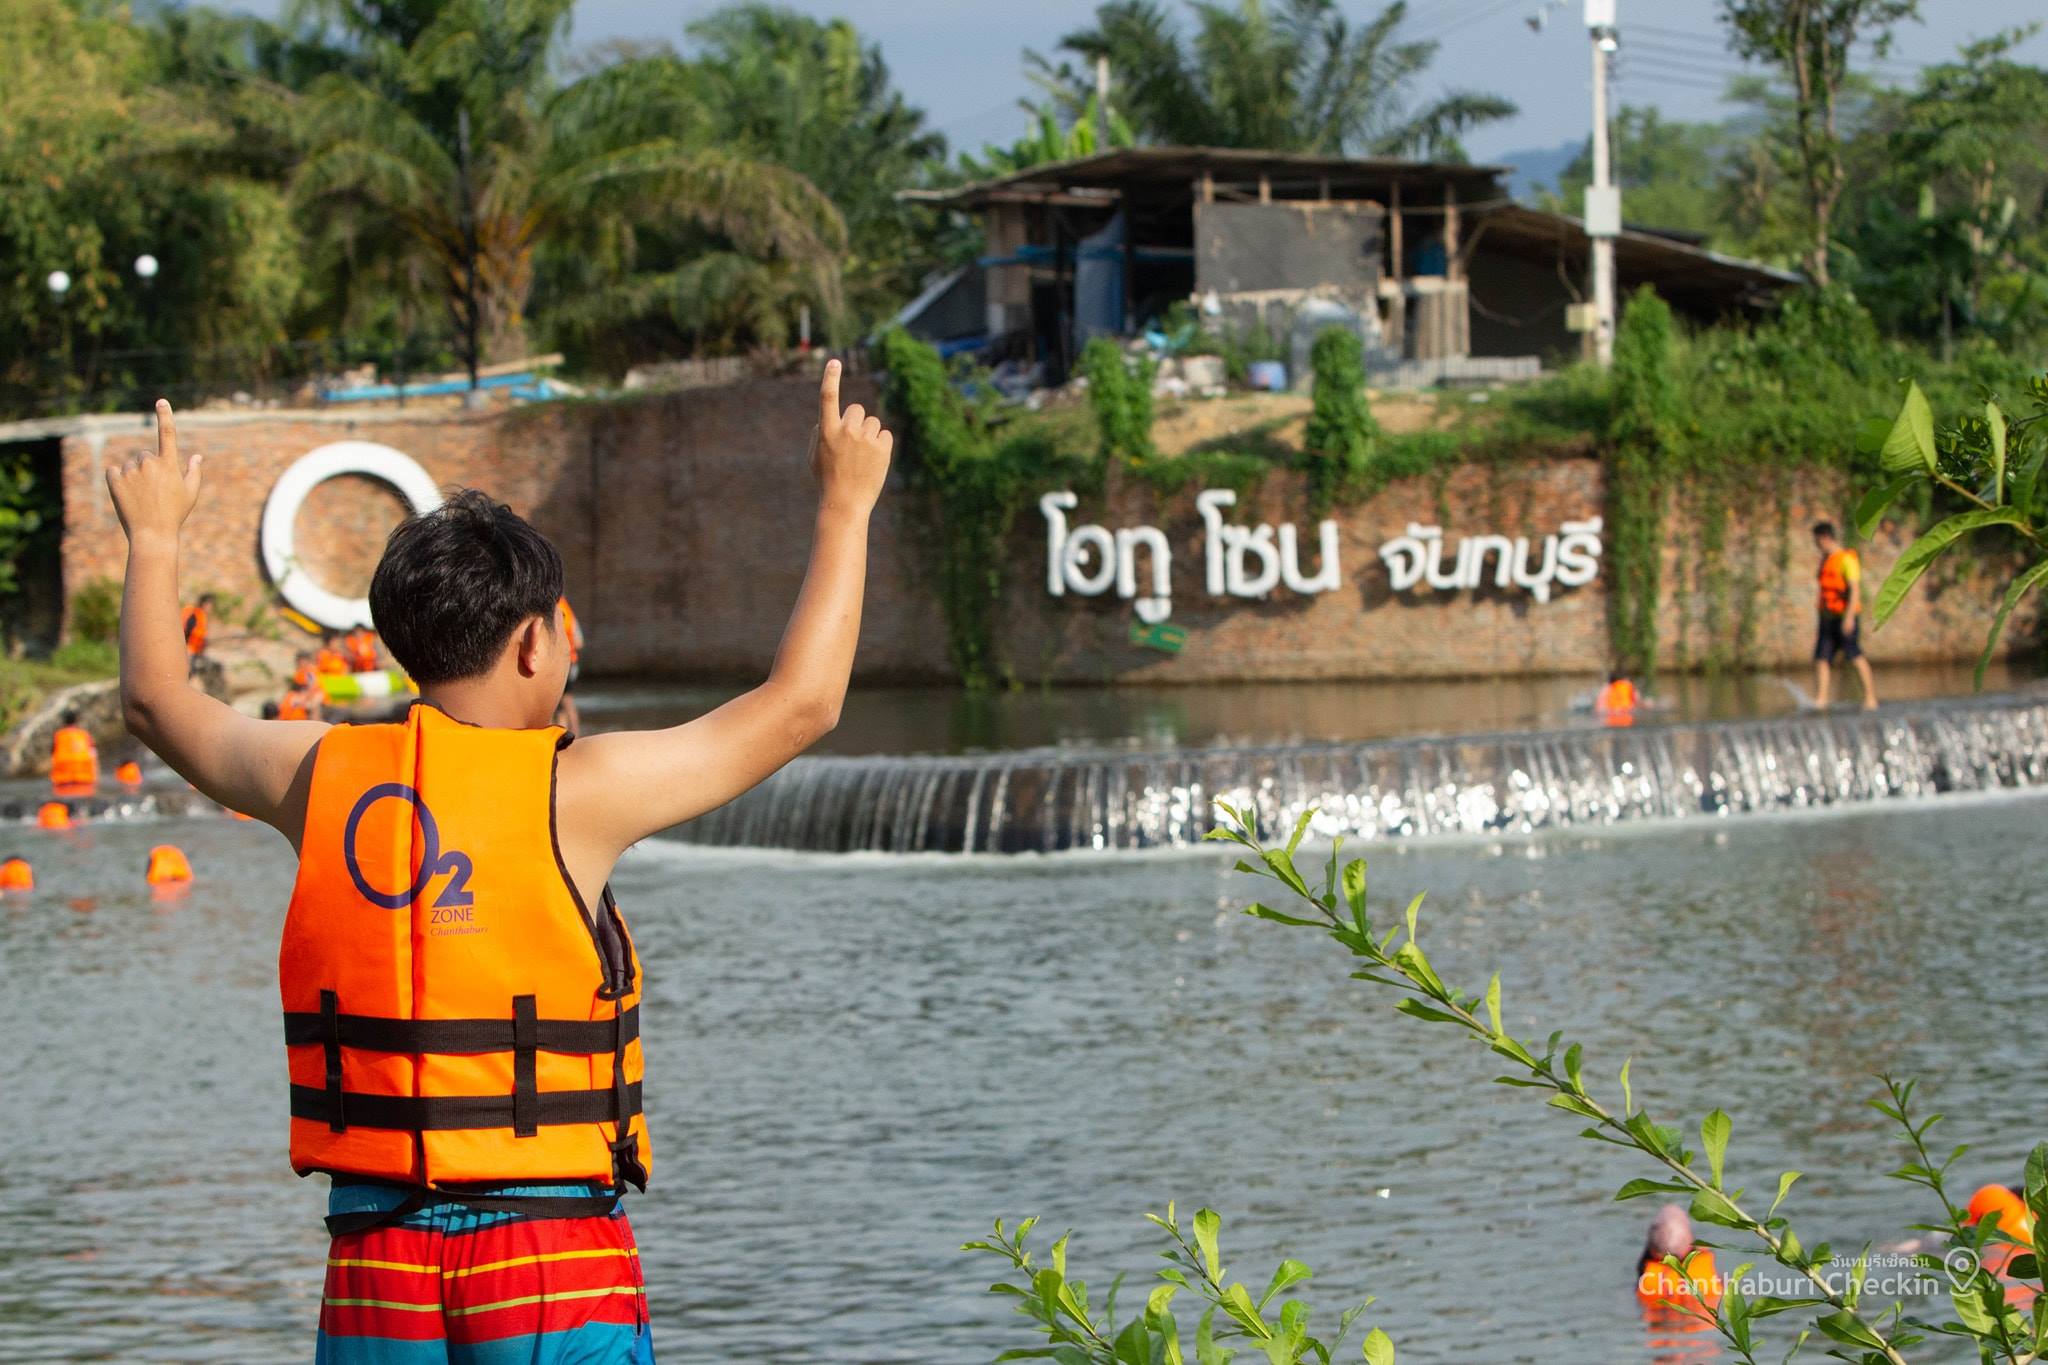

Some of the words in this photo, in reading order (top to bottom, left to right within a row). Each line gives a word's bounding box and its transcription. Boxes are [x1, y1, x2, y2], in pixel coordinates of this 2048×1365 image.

[1040, 491, 1172, 623] โอทู
[1196, 488, 1341, 598] โซน
[1379, 515, 1603, 604] จันทบุรี
[430, 907, 475, 924] ZONE
[430, 924, 489, 937] Chanthaburi
